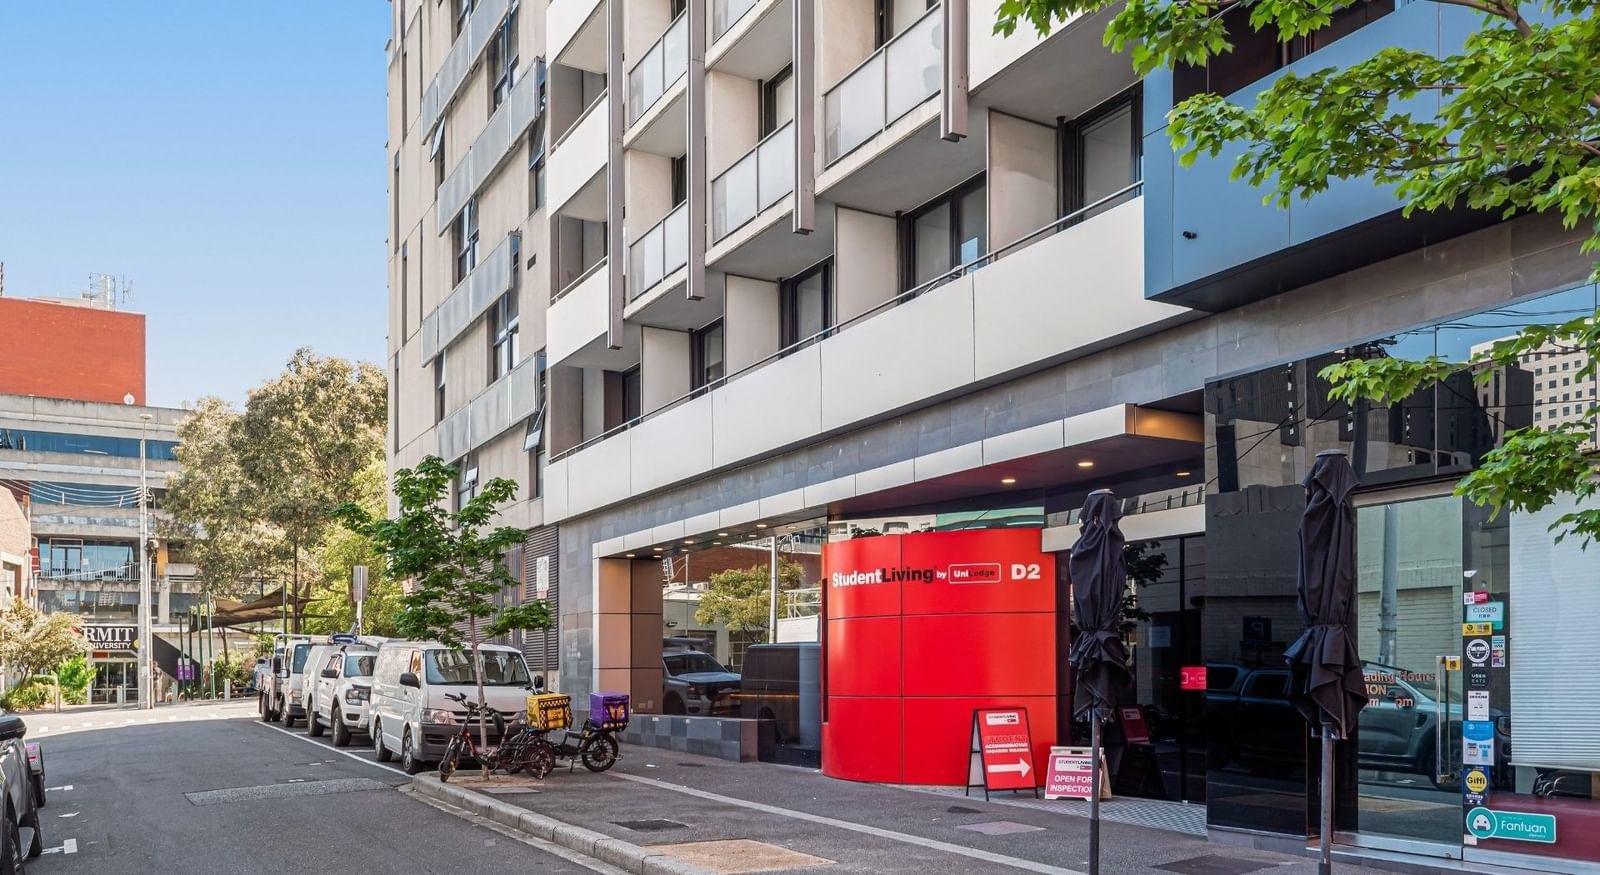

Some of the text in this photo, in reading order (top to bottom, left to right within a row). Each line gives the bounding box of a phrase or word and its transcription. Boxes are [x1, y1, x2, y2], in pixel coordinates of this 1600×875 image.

[937, 570, 947, 579] by
[953, 569, 995, 578] UniLodge
[1011, 564, 1040, 580] D2
[84, 627, 134, 641] RMIT
[1363, 671, 1436, 684] ading Hours
[1054, 775, 1076, 783] OPEN
[1501, 820, 1547, 833] Fantuan
